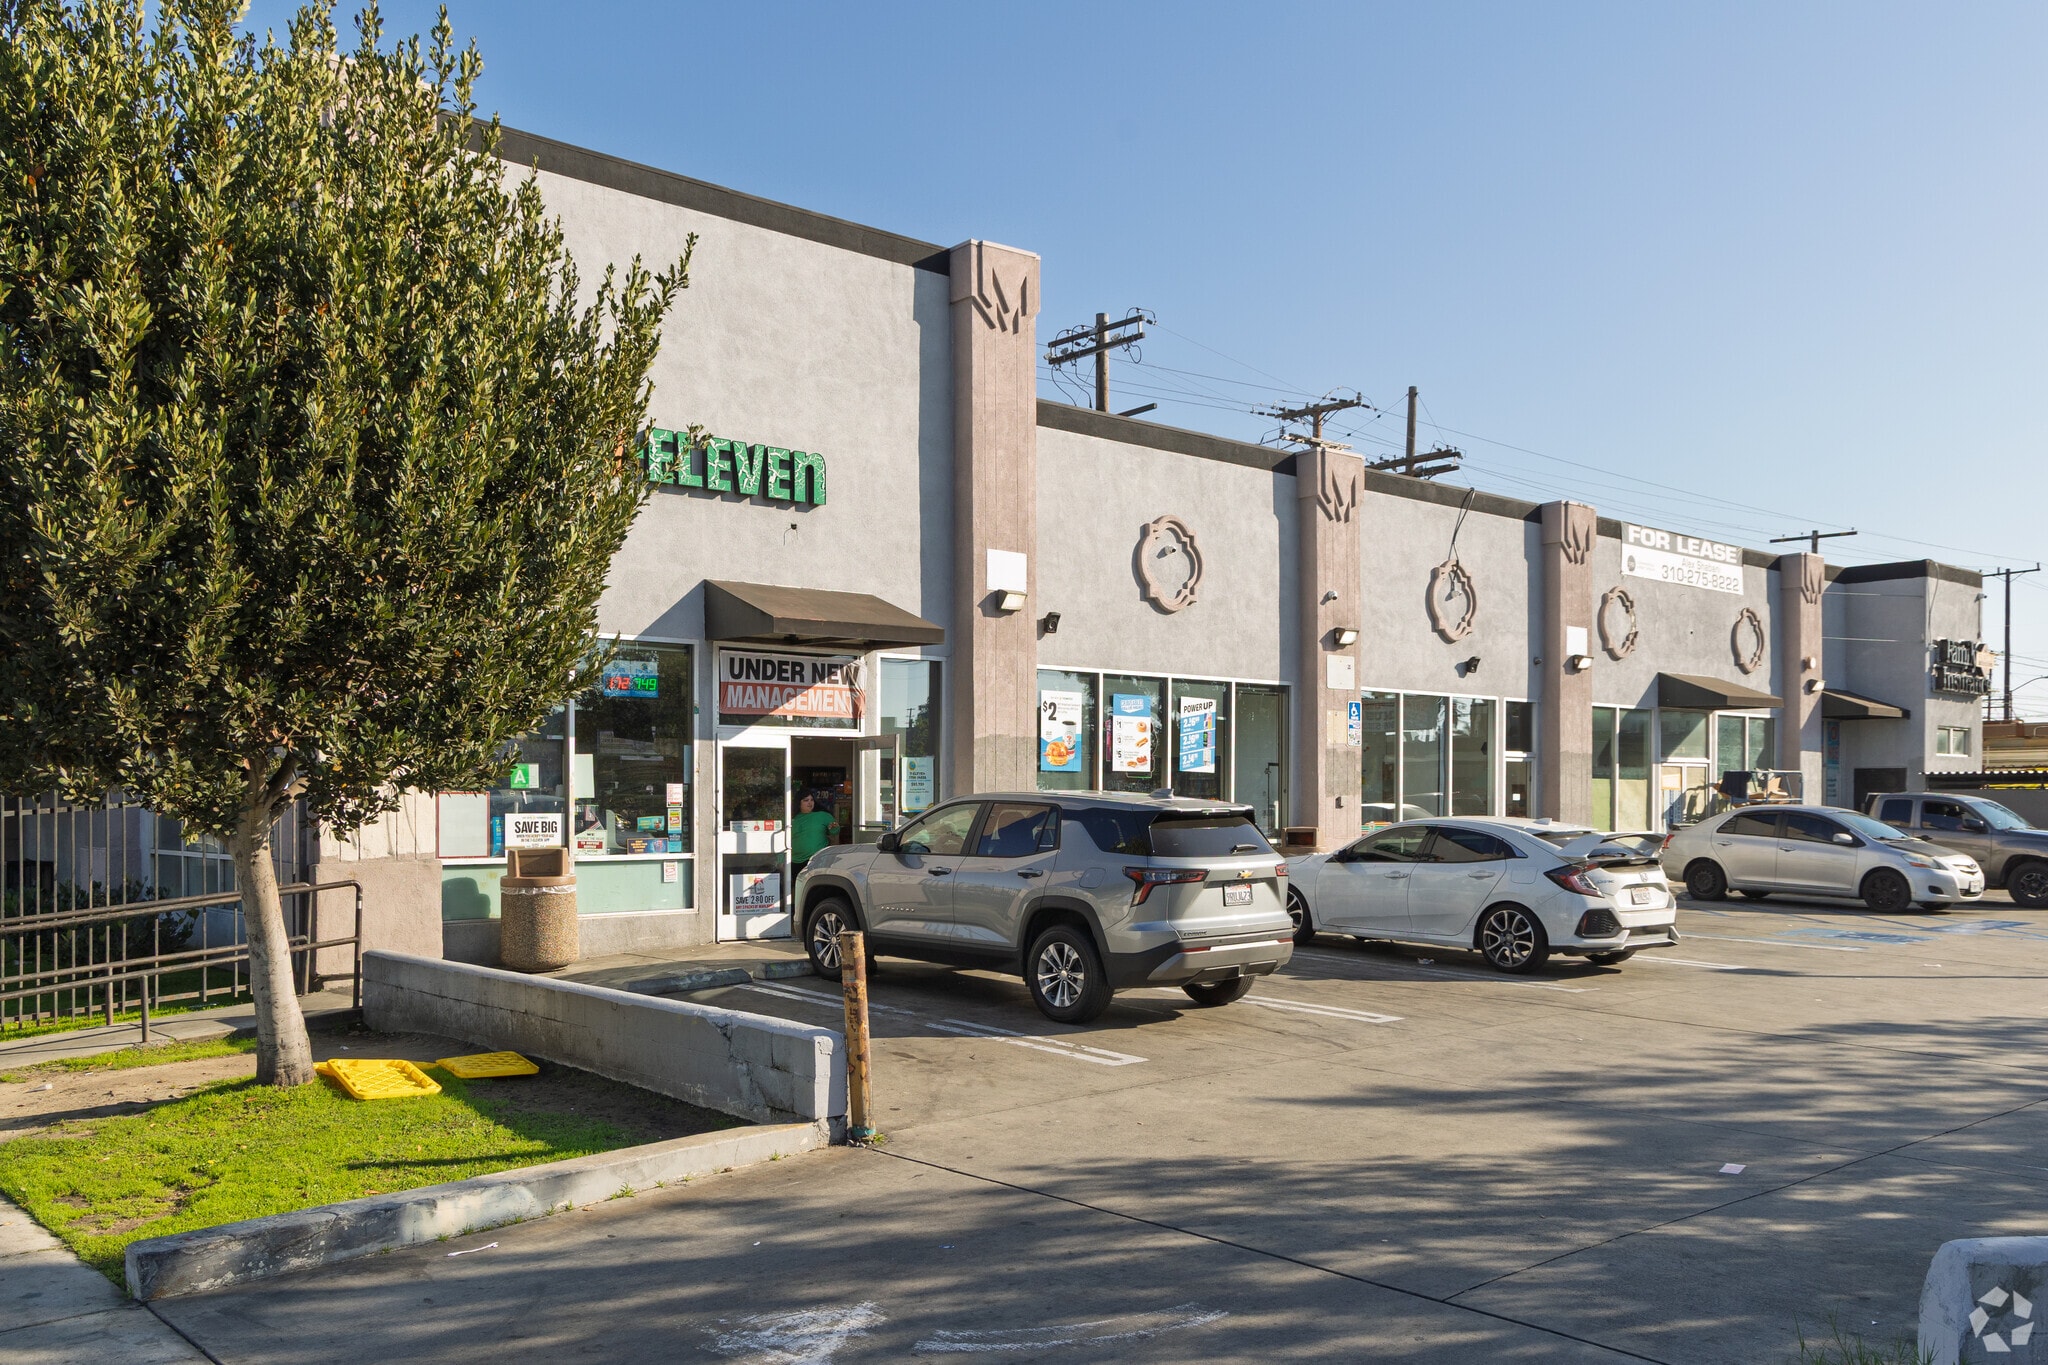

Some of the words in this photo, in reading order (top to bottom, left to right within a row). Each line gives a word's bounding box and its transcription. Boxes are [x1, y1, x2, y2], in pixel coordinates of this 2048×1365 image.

[1628, 525, 1670, 550] FOR
[1677, 535, 1737, 563] LEASE
[1661, 564, 1739, 592] 310-275-8222
[729, 657, 804, 684] UNDER
[812, 662, 860, 686] NEW
[634, 678, 657, 691] 749
[726, 684, 853, 714] MANAGEMENT
[1183, 703, 1203, 713] POWER
[1203, 701, 1213, 710] UP
[1042, 700, 1057, 721] $2
[514, 769, 526, 784] A
[514, 820, 539, 834] SAVE
[541, 820, 558, 833] BIG
[735, 896, 749, 905] SAVE
[764, 895, 775, 904] OFF
